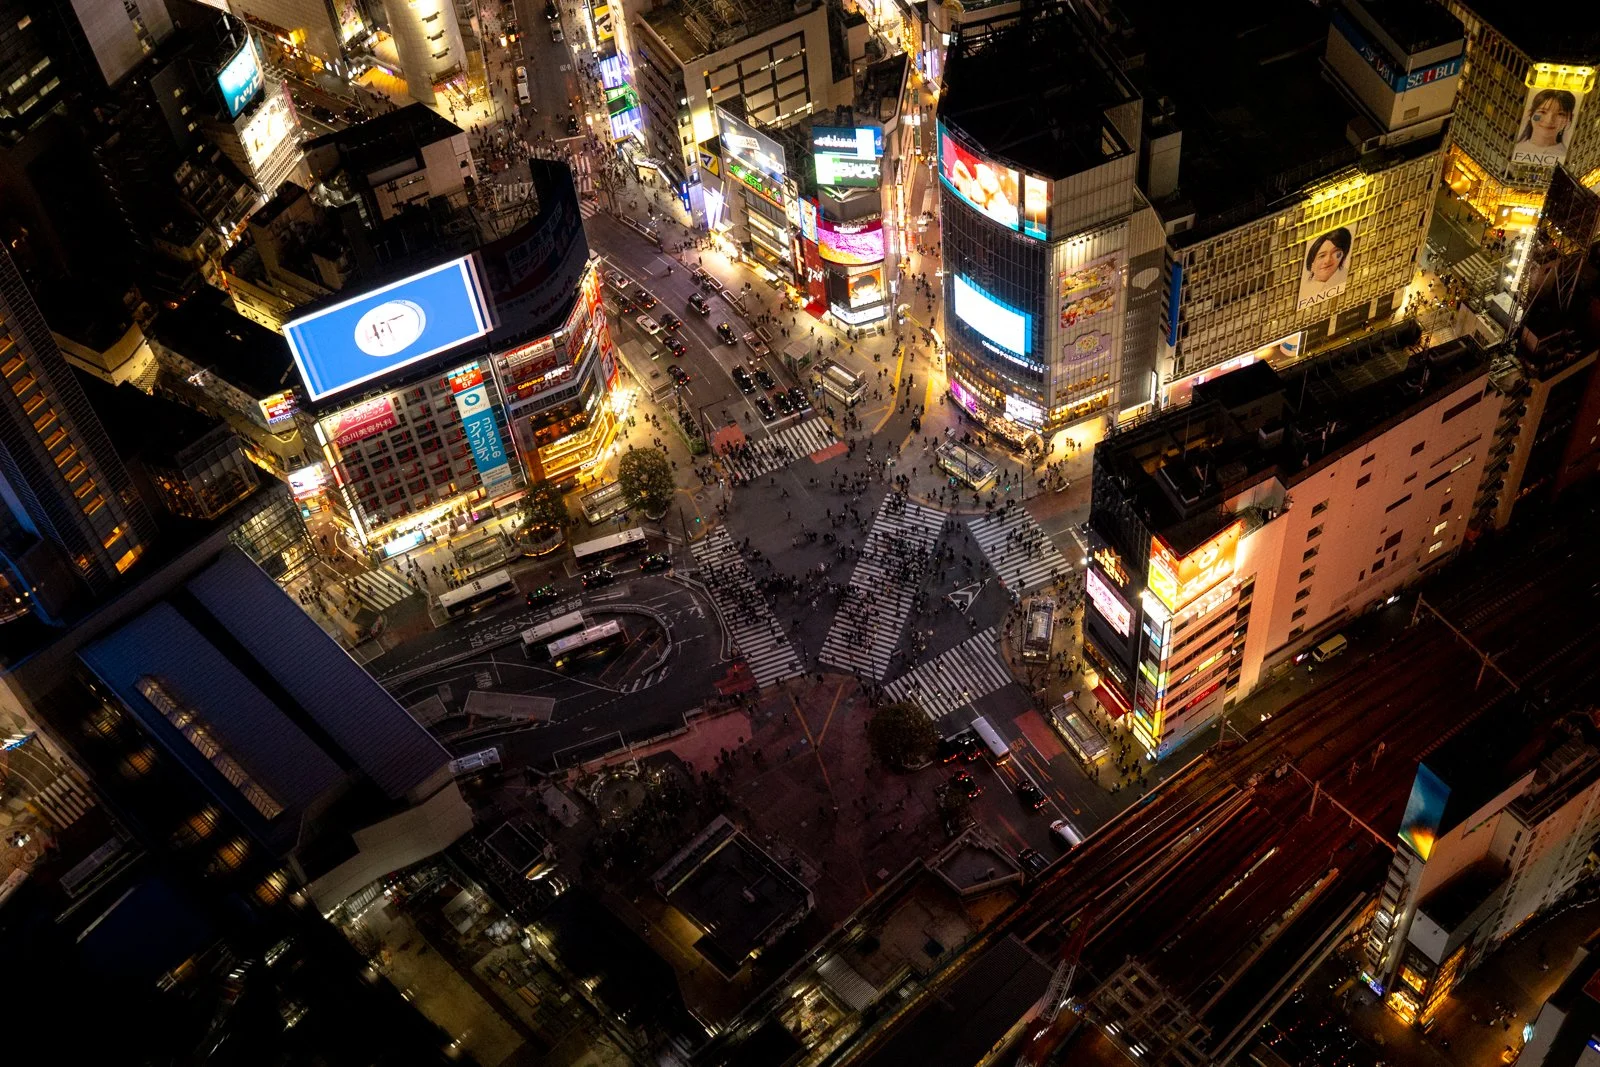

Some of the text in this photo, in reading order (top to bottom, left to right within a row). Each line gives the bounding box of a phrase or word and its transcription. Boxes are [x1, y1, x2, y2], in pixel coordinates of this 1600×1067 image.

[1406, 62, 1455, 89] SEIBU
[1298, 285, 1345, 311] FANCL
[354, 403, 387, 422] クリニック
[341, 420, 393, 444] 品川美容外科
[468, 420, 491, 462] アイシティ
[481, 416, 501, 459] コンタクトの
